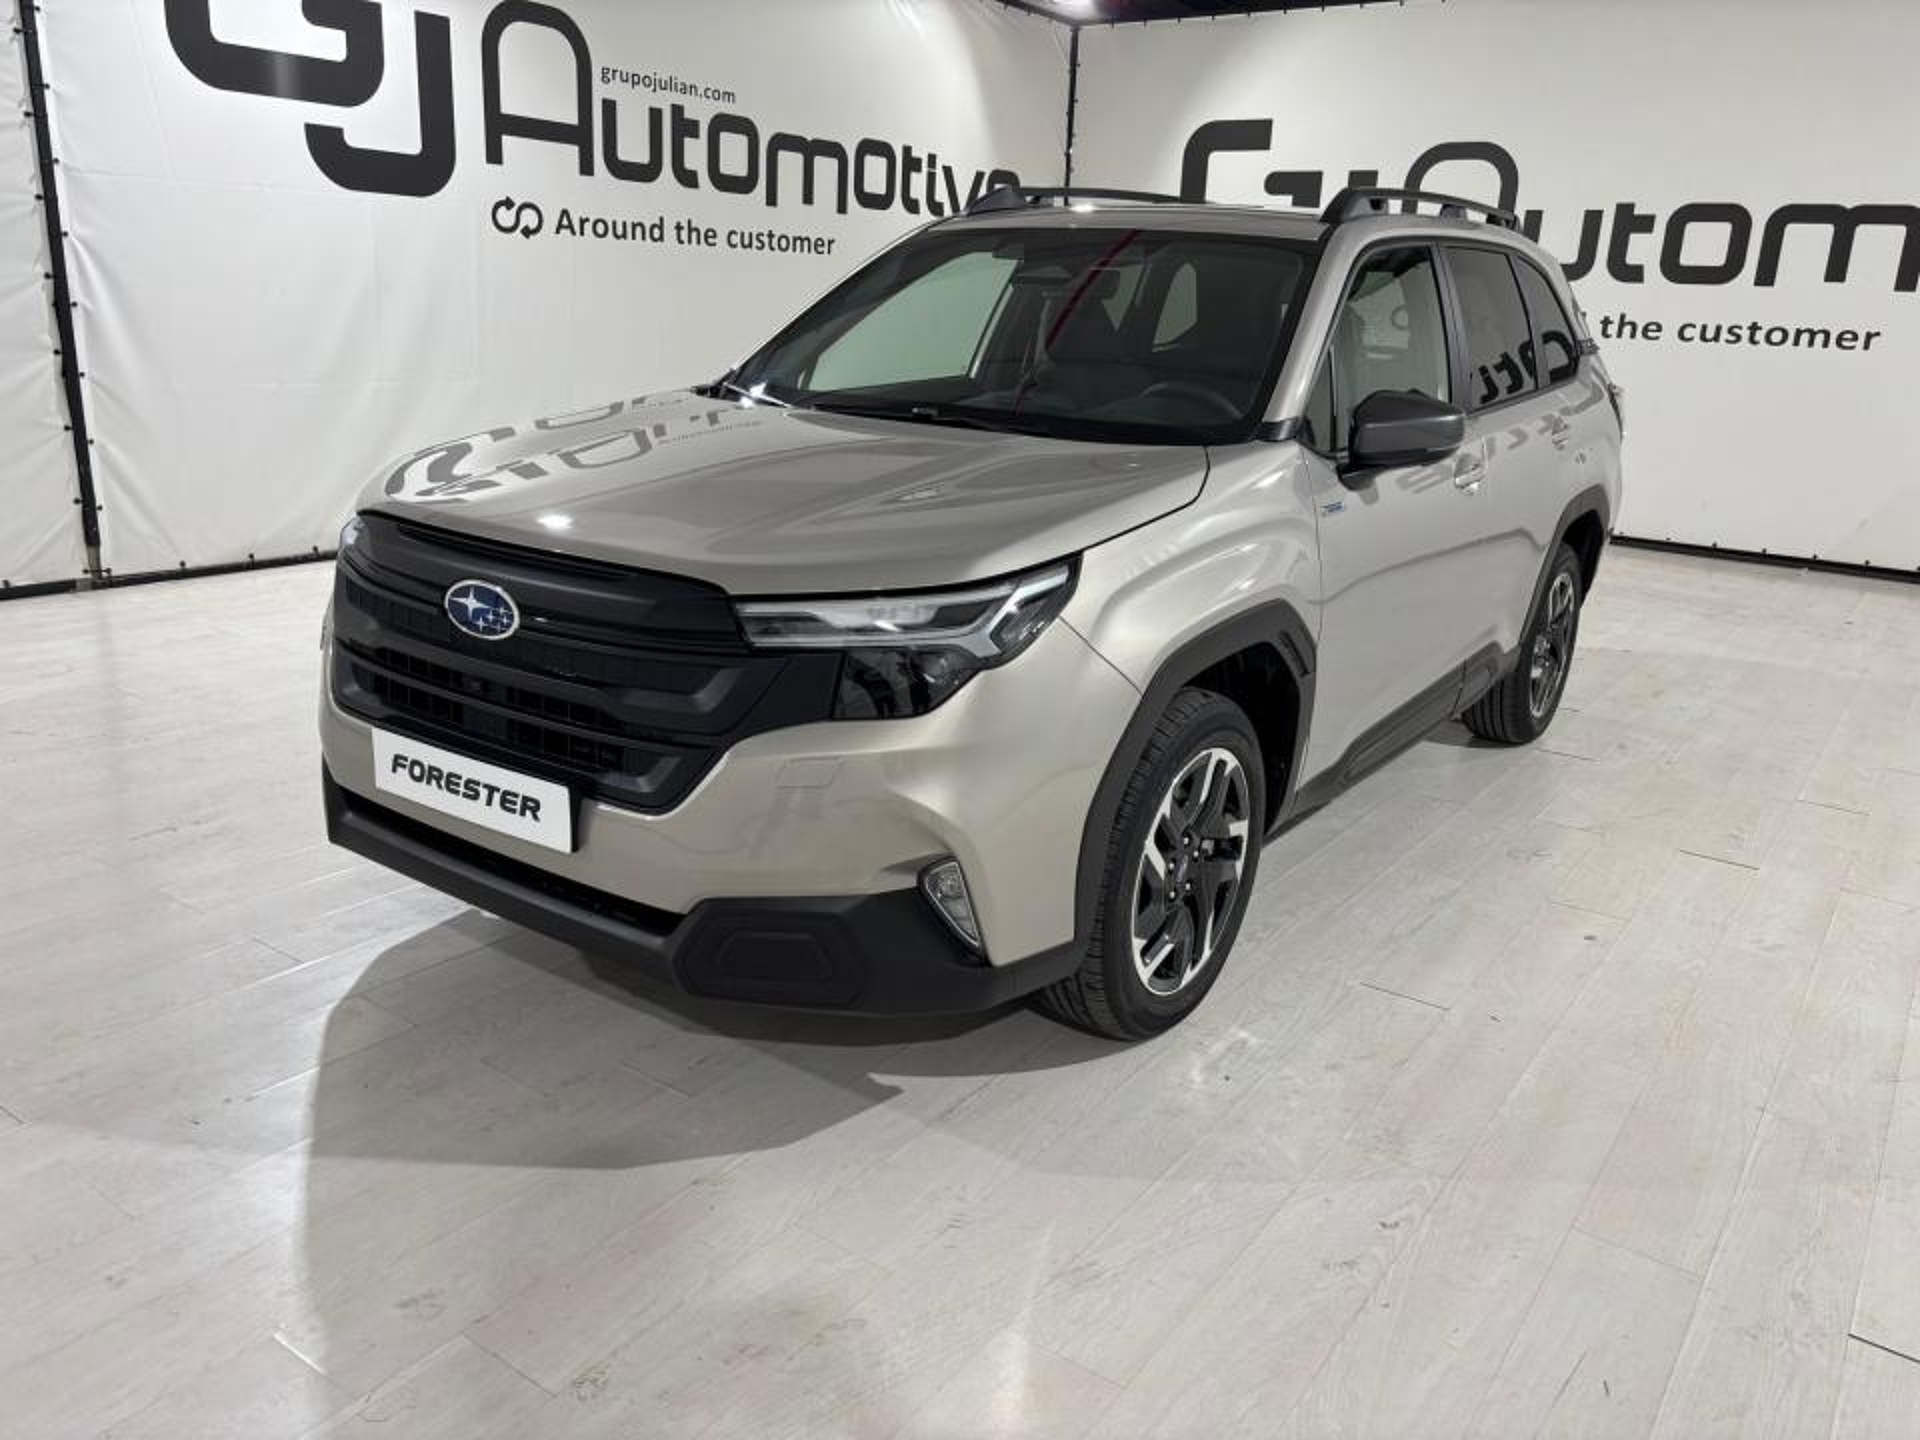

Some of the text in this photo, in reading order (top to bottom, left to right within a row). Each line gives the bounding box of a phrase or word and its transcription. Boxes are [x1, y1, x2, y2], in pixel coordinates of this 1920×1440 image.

[601, 66, 736, 103] grupojulian.com
[555, 208, 835, 255] Around the customer
[1599, 313, 1881, 351] the customer
[391, 753, 541, 822] FORESTER
